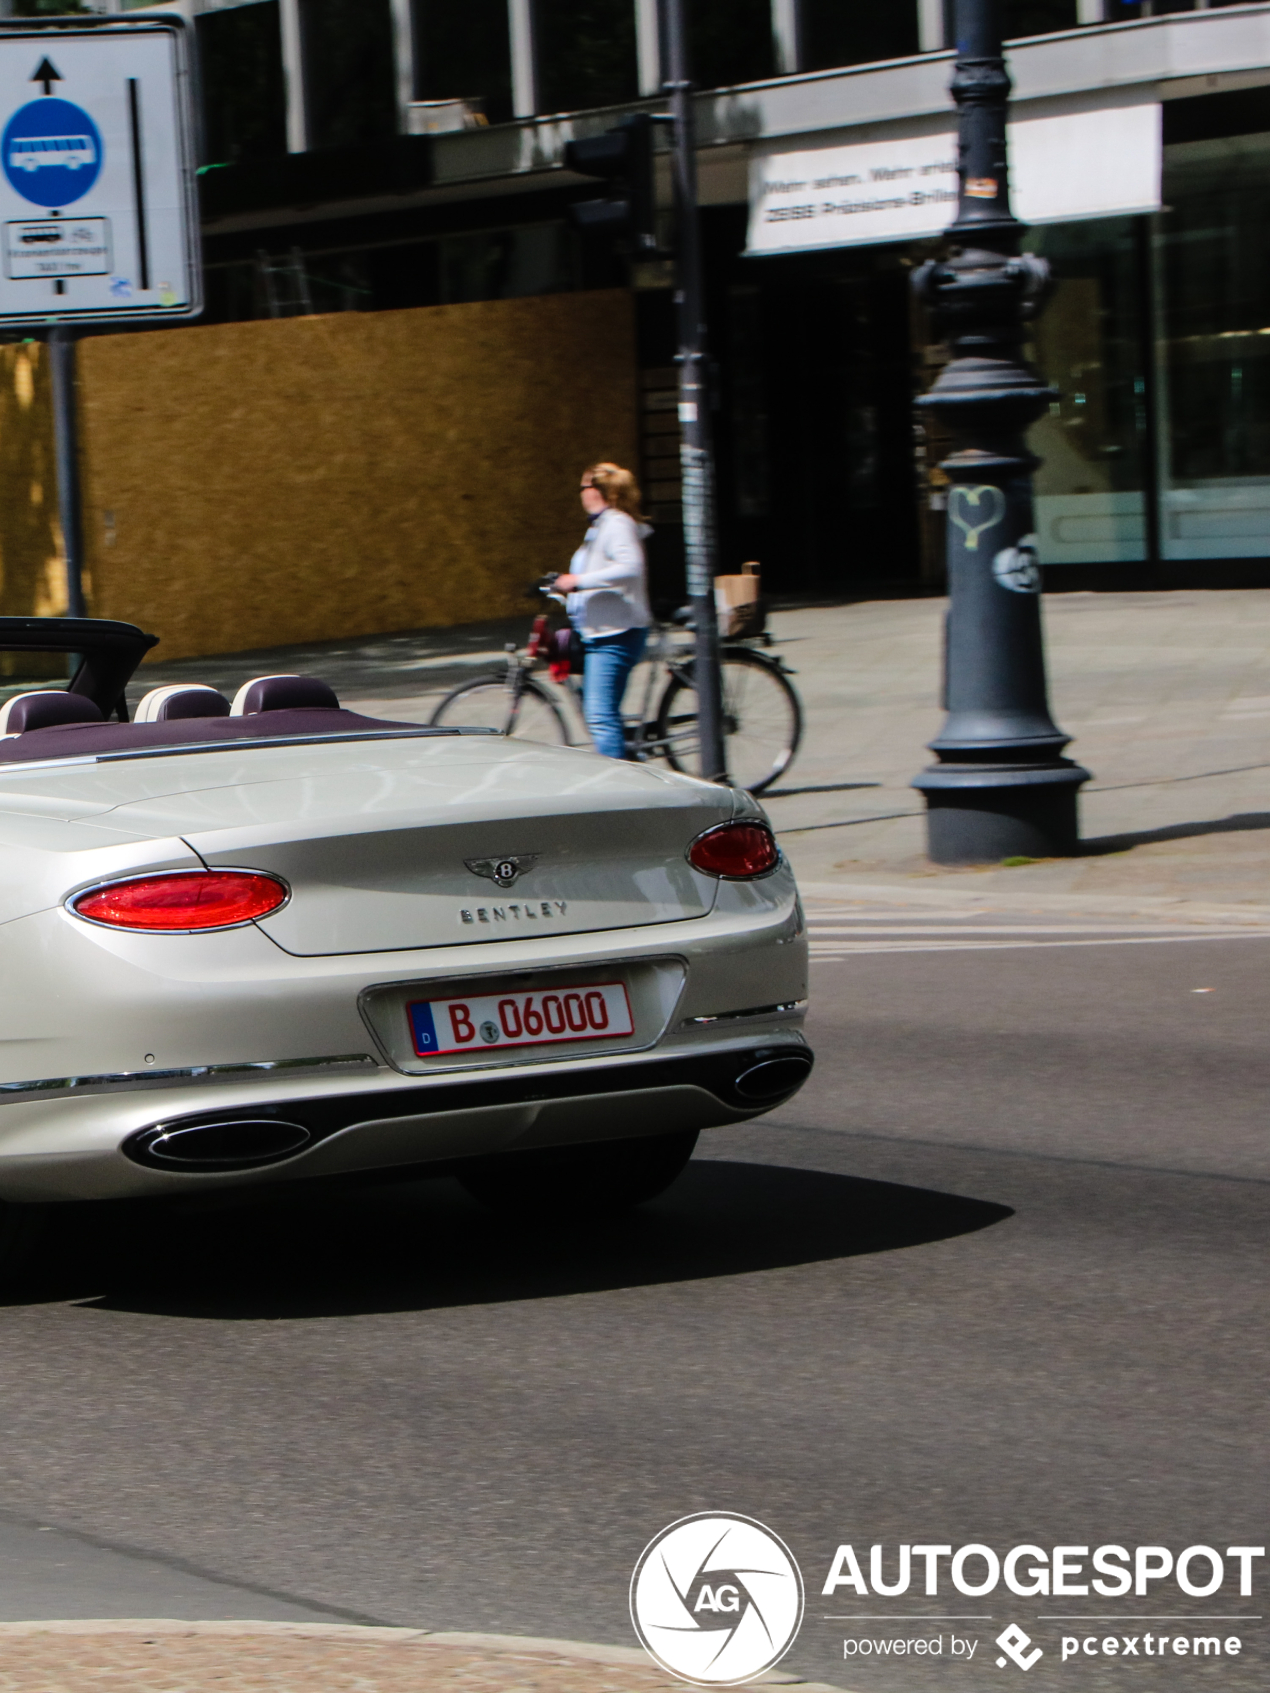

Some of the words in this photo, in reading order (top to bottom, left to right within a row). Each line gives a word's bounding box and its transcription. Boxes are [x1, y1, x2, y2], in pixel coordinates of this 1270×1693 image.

[500, 862, 513, 878] B
[459, 901, 568, 924] BENTLEY
[422, 1032, 431, 1044] D
[448, 1003, 476, 1044] B
[498, 991, 610, 1038] 06000
